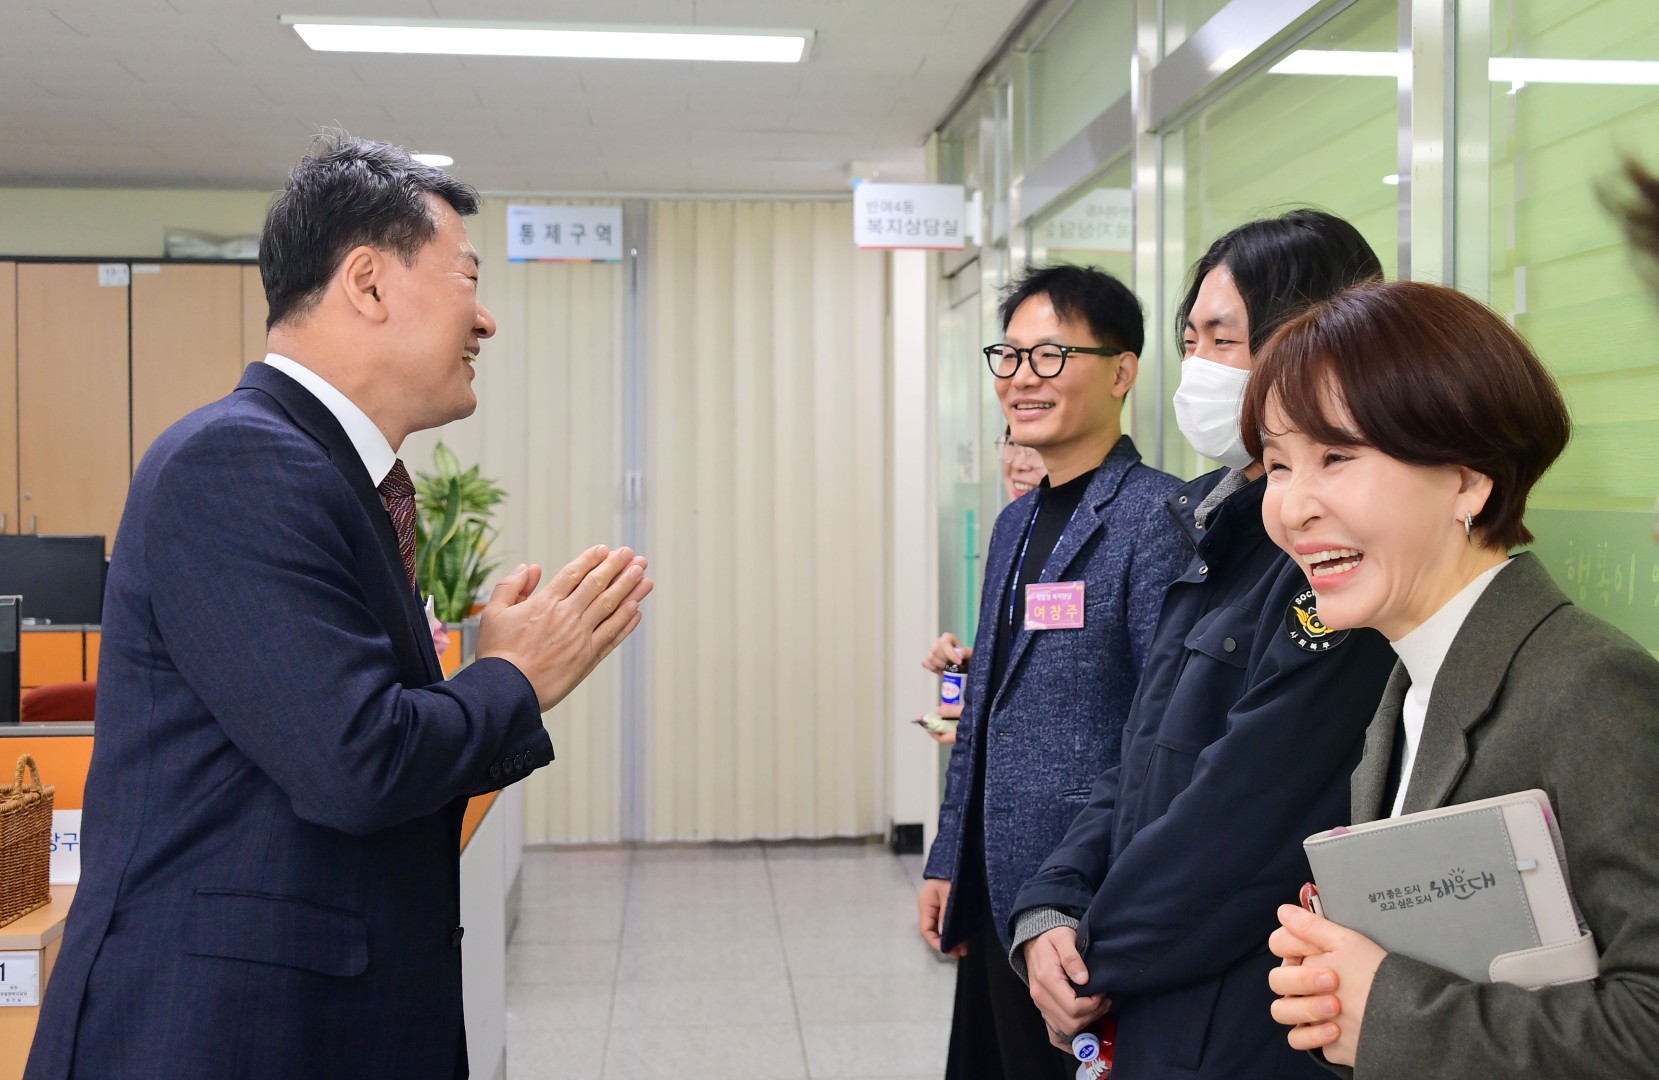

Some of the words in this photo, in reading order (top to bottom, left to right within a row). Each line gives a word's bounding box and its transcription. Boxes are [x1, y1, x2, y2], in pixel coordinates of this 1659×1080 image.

[867, 218, 958, 237] 복지상담실
[1295, 590, 1316, 605] SOCI
[1033, 604, 1078, 621] 여창주
[1368, 891, 1386, 903] 살기
[1386, 887, 1403, 900] 좋은
[1404, 884, 1421, 895] 도시
[1380, 901, 1397, 911] 오고
[1398, 897, 1414, 909] 싶은
[1415, 894, 1432, 905] 도시
